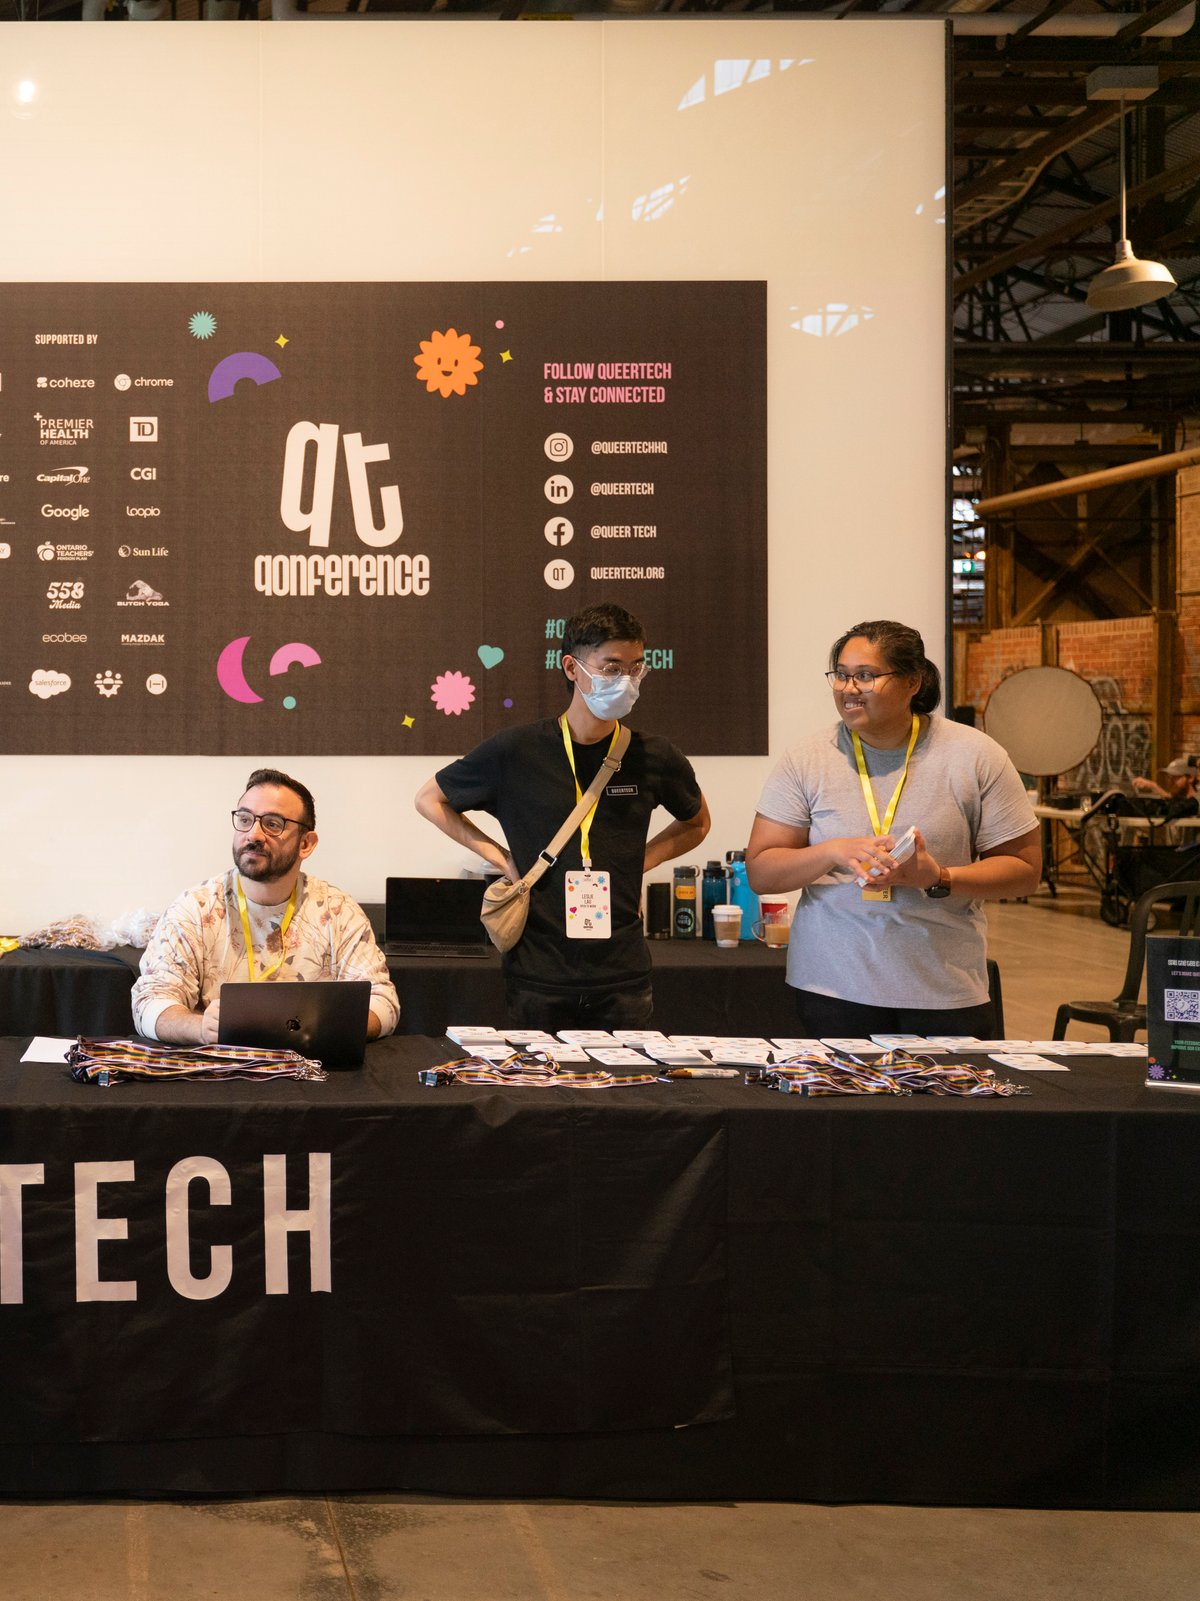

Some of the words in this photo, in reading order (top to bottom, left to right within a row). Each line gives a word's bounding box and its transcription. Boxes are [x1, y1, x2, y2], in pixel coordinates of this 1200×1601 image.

[35, 334, 84, 345] SUPPORTED
[86, 334, 98, 345] BY
[543, 363, 595, 380] FOLLOW
[597, 363, 672, 380] QUEERTECH
[49, 377, 95, 388] cohere
[134, 377, 174, 387] chrome
[544, 386, 554, 403] &
[556, 386, 587, 403] STAY
[590, 386, 666, 403] CONNECTED
[40, 418, 94, 429] PREMIER
[133, 421, 155, 437] TD
[40, 429, 89, 439] HEALTH
[591, 441, 668, 455] @QUEERTECHHQ
[130, 467, 157, 481] CGI
[590, 482, 654, 496] @QUEERTECH
[41, 503, 90, 521] Google
[590, 525, 631, 539] @QUEER
[632, 525, 657, 539] TECH
[132, 547, 151, 557] Sun
[152, 547, 169, 557] Life
[254, 554, 430, 597] qonference
[552, 567, 566, 581] QT
[590, 566, 665, 580] QUEERTECH.ORG
[46, 581, 85, 600] 558
[49, 599, 81, 610] Media
[42, 632, 87, 643] ecobee
[121, 634, 165, 643] MAZDAK
